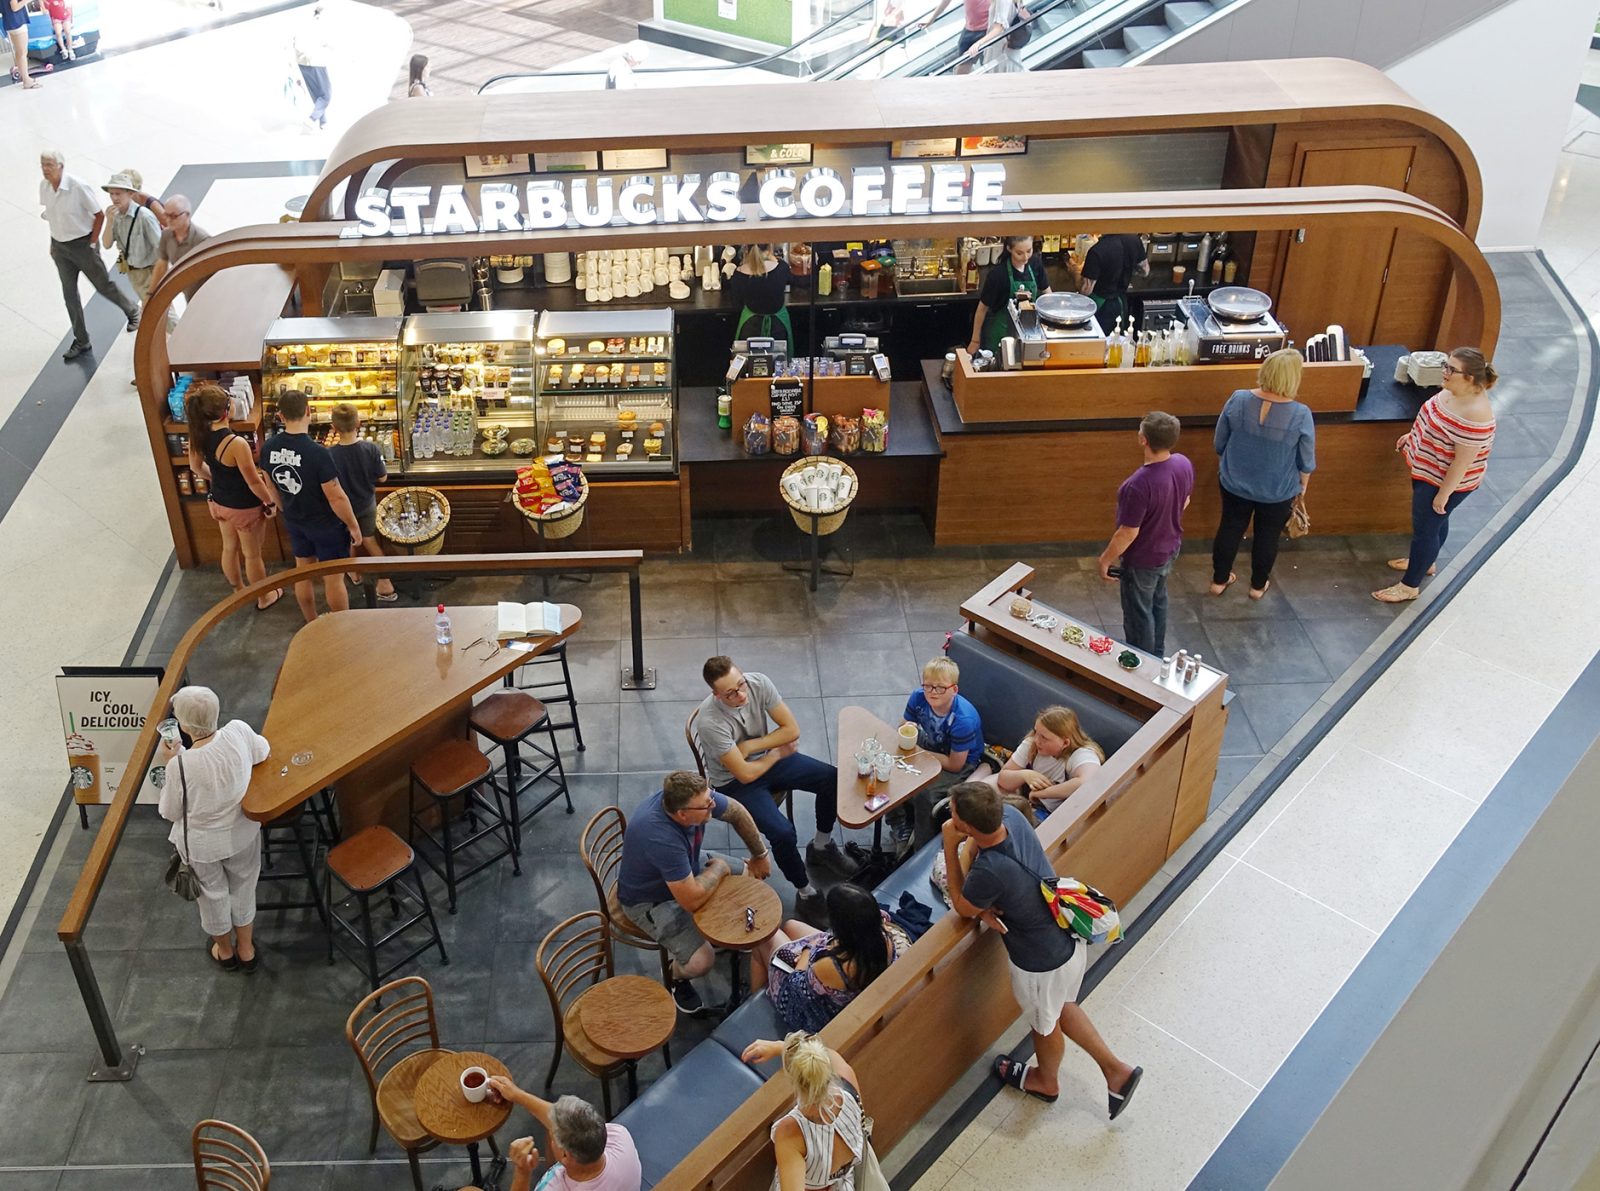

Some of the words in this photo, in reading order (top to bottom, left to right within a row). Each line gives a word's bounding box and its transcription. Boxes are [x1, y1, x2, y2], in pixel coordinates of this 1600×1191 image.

[770, 149, 778, 158] &
[780, 149, 804, 158] COLD
[355, 172, 741, 236] STARBUCKS
[759, 163, 1006, 218] COFFEE
[1212, 344, 1227, 353] FREE
[1228, 344, 1251, 354] DRINKS
[90, 691, 112, 703] ICY,
[103, 704, 139, 716] COOL,
[81, 716, 147, 728] DELICIOUS
